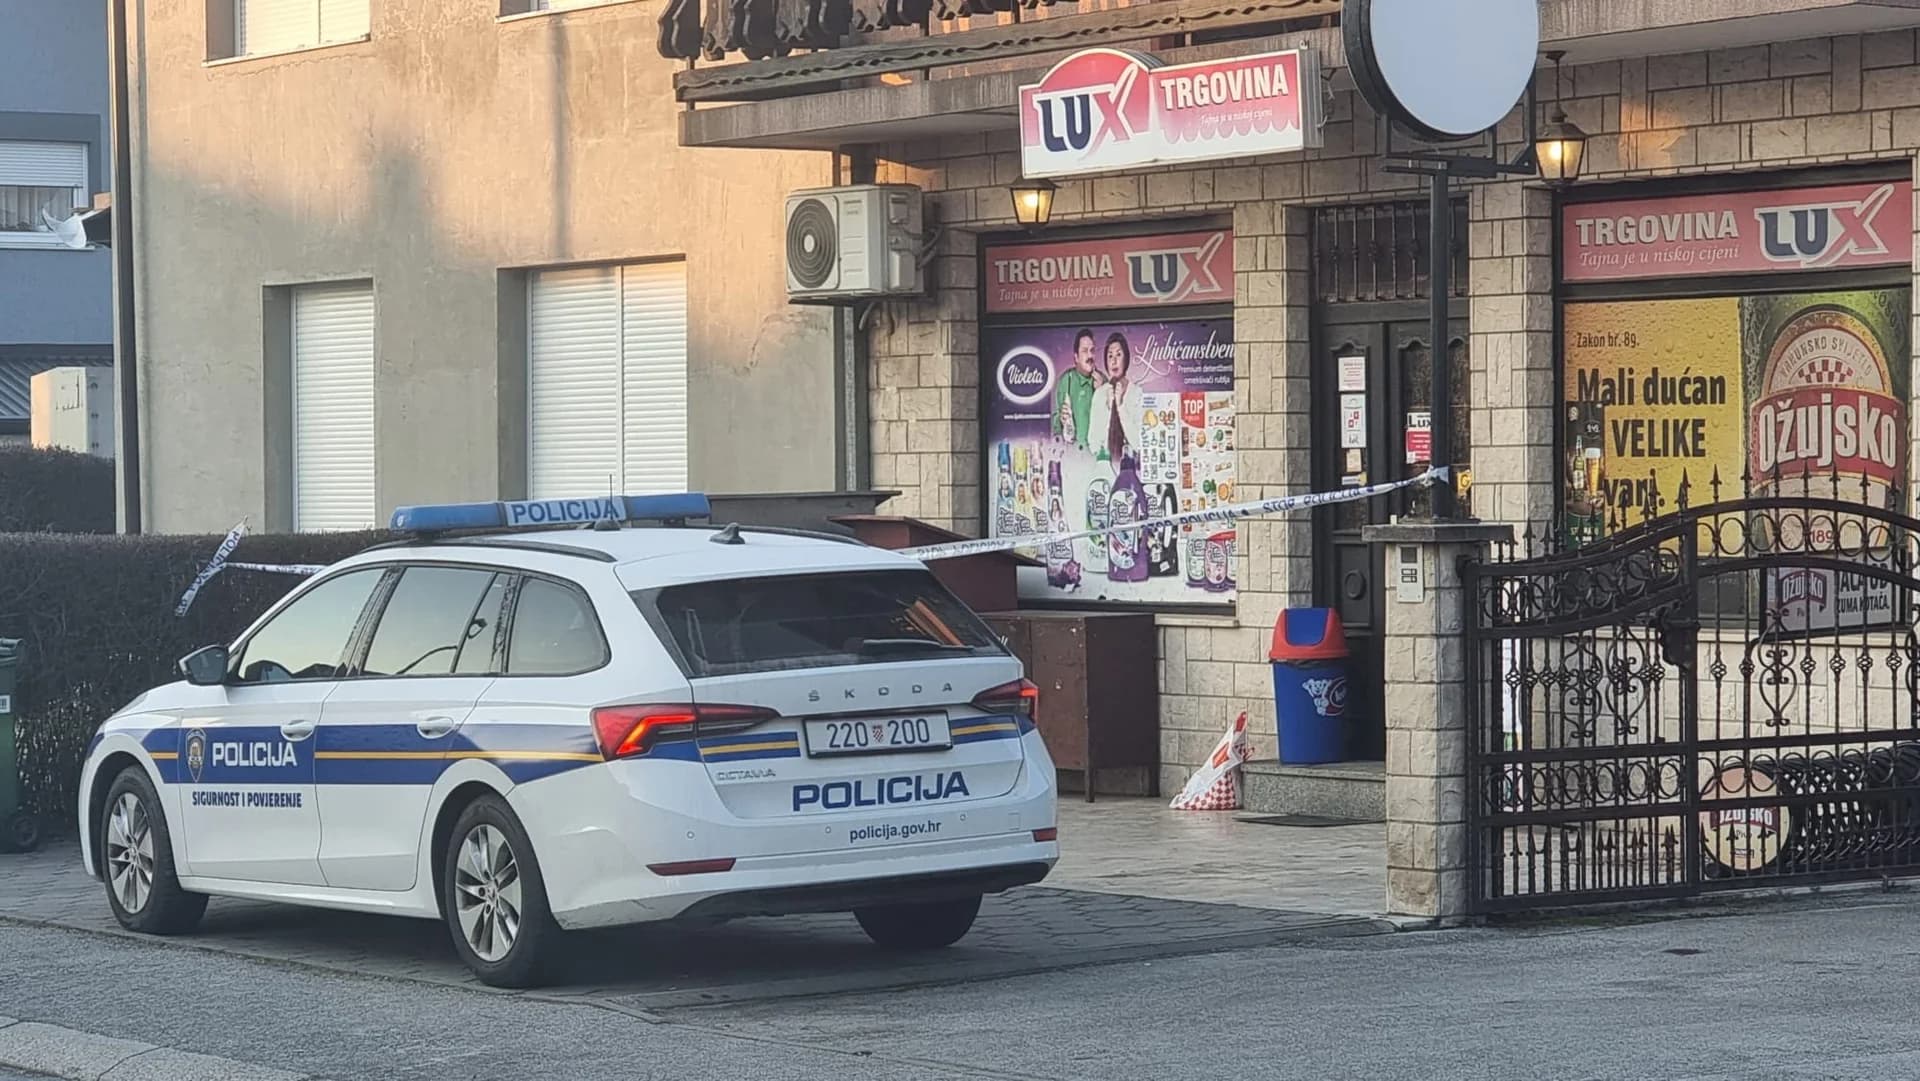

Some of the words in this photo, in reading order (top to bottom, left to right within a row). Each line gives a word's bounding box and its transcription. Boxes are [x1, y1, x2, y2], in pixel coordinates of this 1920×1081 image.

[1160, 64, 1289, 110] TRGOVINA
[1033, 62, 1139, 162] LUX
[1576, 210, 1740, 247] TRGOVINA
[1754, 183, 1896, 267] LUX
[995, 254, 1115, 284] TRGOVINA
[1124, 232, 1225, 303] LUX
[1579, 251, 1619, 270] Tajna
[1622, 250, 1636, 268] je
[1640, 252, 1650, 263] u
[1653, 247, 1694, 266] niskoj
[1698, 246, 1740, 265] cijeni
[999, 288, 1028, 304] Tajna
[1030, 288, 1040, 304] je
[1042, 289, 1050, 299] u
[1052, 284, 1083, 300] niskoj
[1084, 283, 1115, 299] cijeni
[1576, 332, 1605, 348] Zakon
[1608, 331, 1621, 347] br.
[1623, 331, 1641, 348] 89.
[1007, 364, 1044, 385] Violeta
[1578, 367, 1635, 407] Mali
[1643, 366, 1726, 405] dućan
[1183, 399, 1204, 415] TOP
[1611, 419, 1706, 457] VELIKE
[1758, 392, 1898, 473] Ožujsko
[1602, 468, 1665, 507] vari.
[510, 499, 620, 524] POLICIJA
[1812, 529, 1834, 544] 189
[1782, 572, 1824, 603] Ožujko
[808, 682, 953, 702] ŠKODA
[826, 721, 868, 749] 220
[887, 718, 931, 745] 200
[211, 741, 298, 768] POLICIJA
[192, 791, 240, 807] SIGURNOST
[241, 791, 246, 807] I
[247, 791, 303, 808] POVJERENJE
[793, 770, 971, 812] POLICIJA
[850, 819, 942, 843] policija.gov.hr
